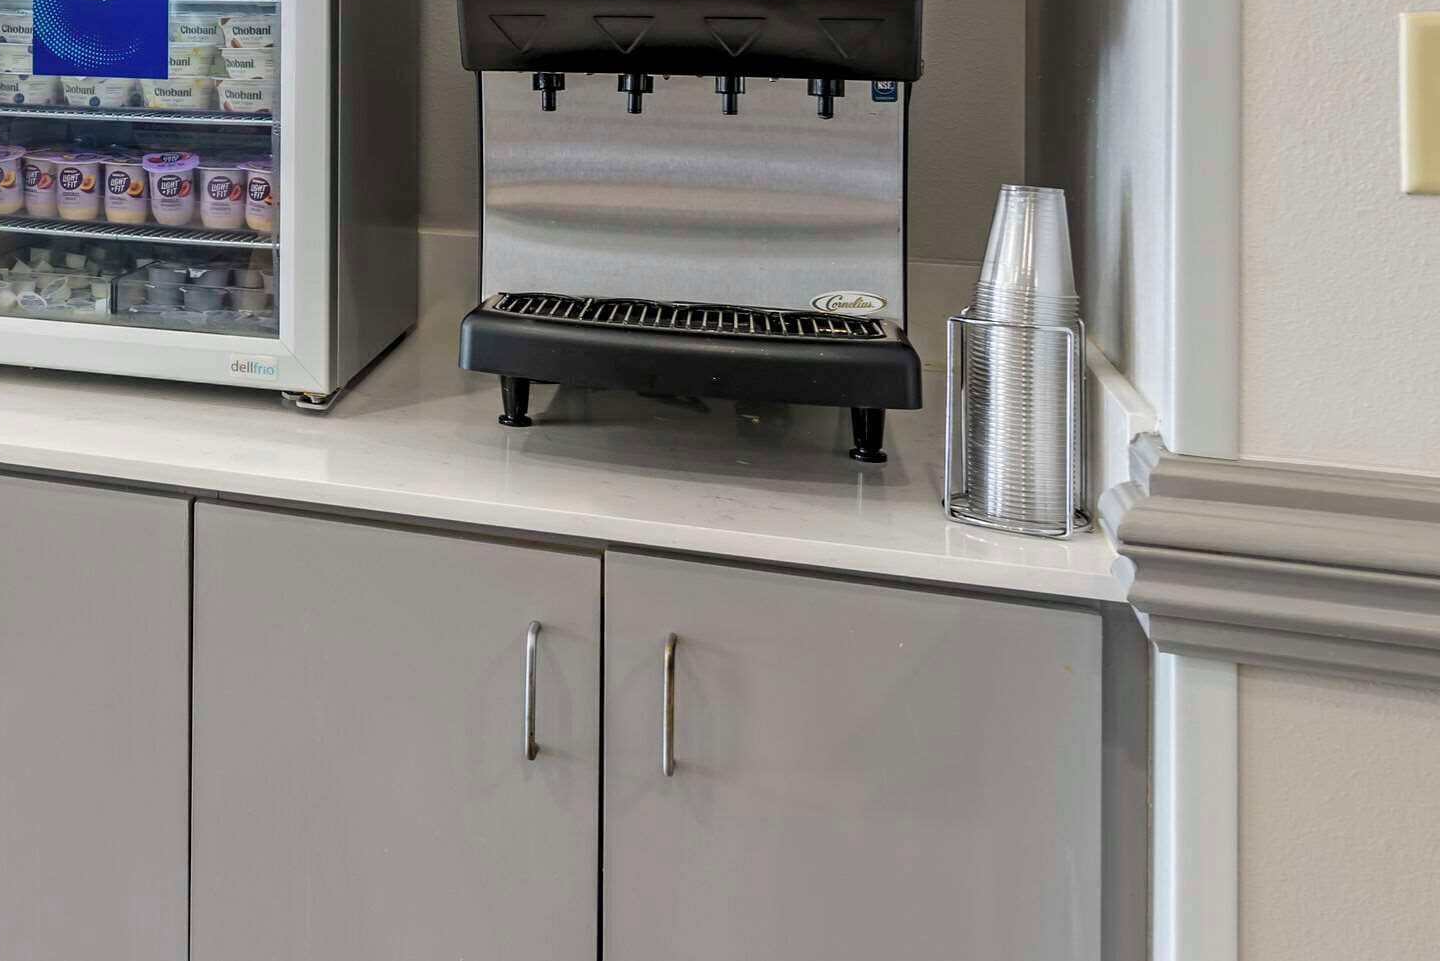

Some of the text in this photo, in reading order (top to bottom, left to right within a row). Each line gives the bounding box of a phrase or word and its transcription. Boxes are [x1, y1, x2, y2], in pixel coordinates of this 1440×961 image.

[180, 25, 217, 35] Chobani
[232, 25, 271, 36] Chobani
[169, 56, 191, 67] bani
[154, 87, 192, 97] Chobani
[224, 89, 262, 101] Chobani
[826, 294, 873, 312] Cornelius
[231, 359, 274, 376] dellfrio
